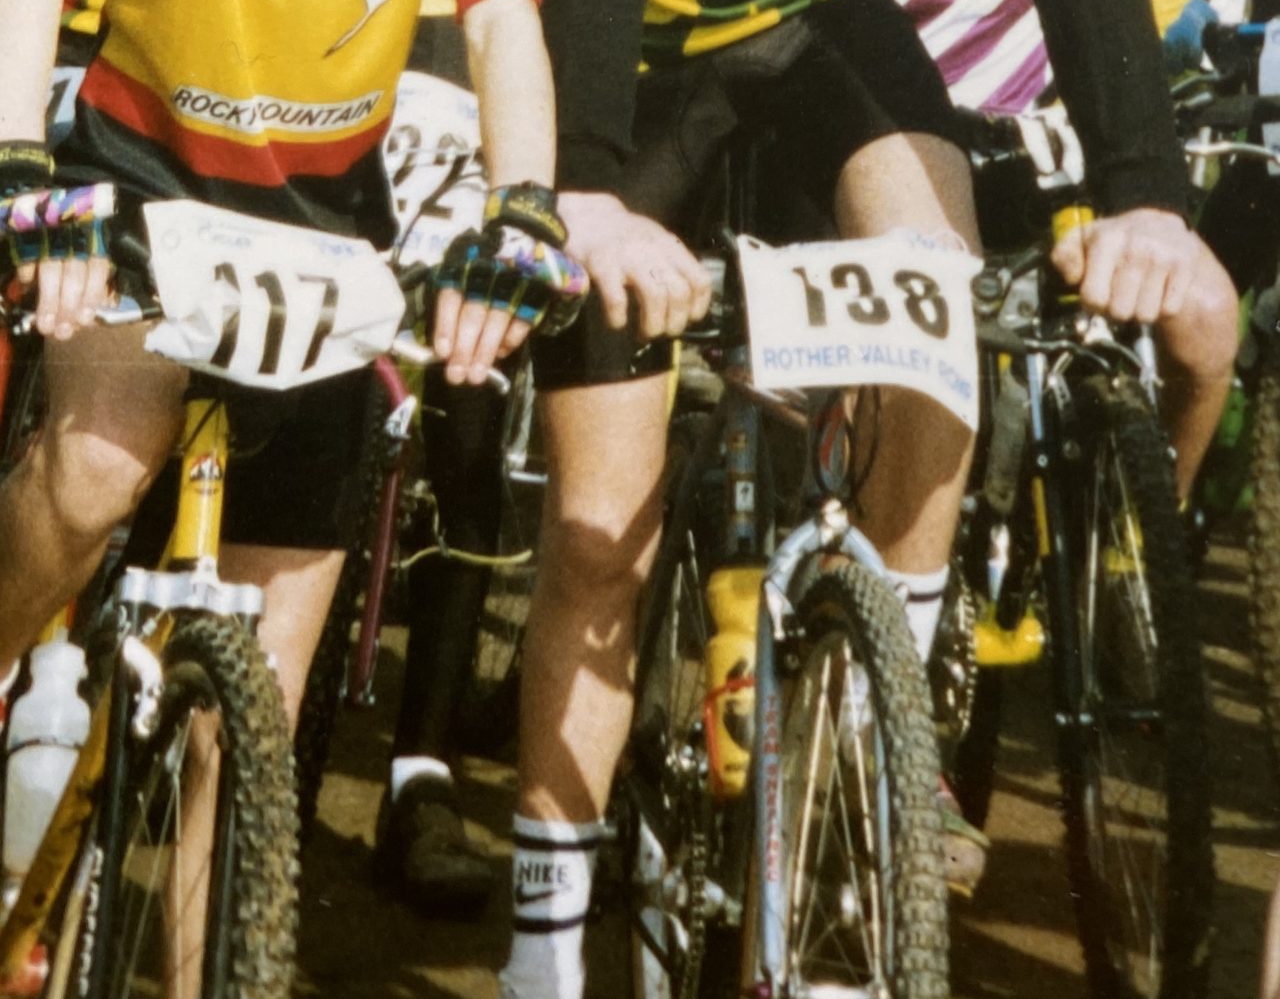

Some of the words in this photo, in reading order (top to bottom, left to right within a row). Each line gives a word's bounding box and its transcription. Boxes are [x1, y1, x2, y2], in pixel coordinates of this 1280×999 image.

[256, 94, 381, 127] OUNTAIN
[791, 262, 950, 340] 138
[210, 262, 339, 375] 117
[762, 344, 852, 371] ROTHER
[859, 344, 932, 373] VALLEY
[519, 861, 569, 884] NIKE
